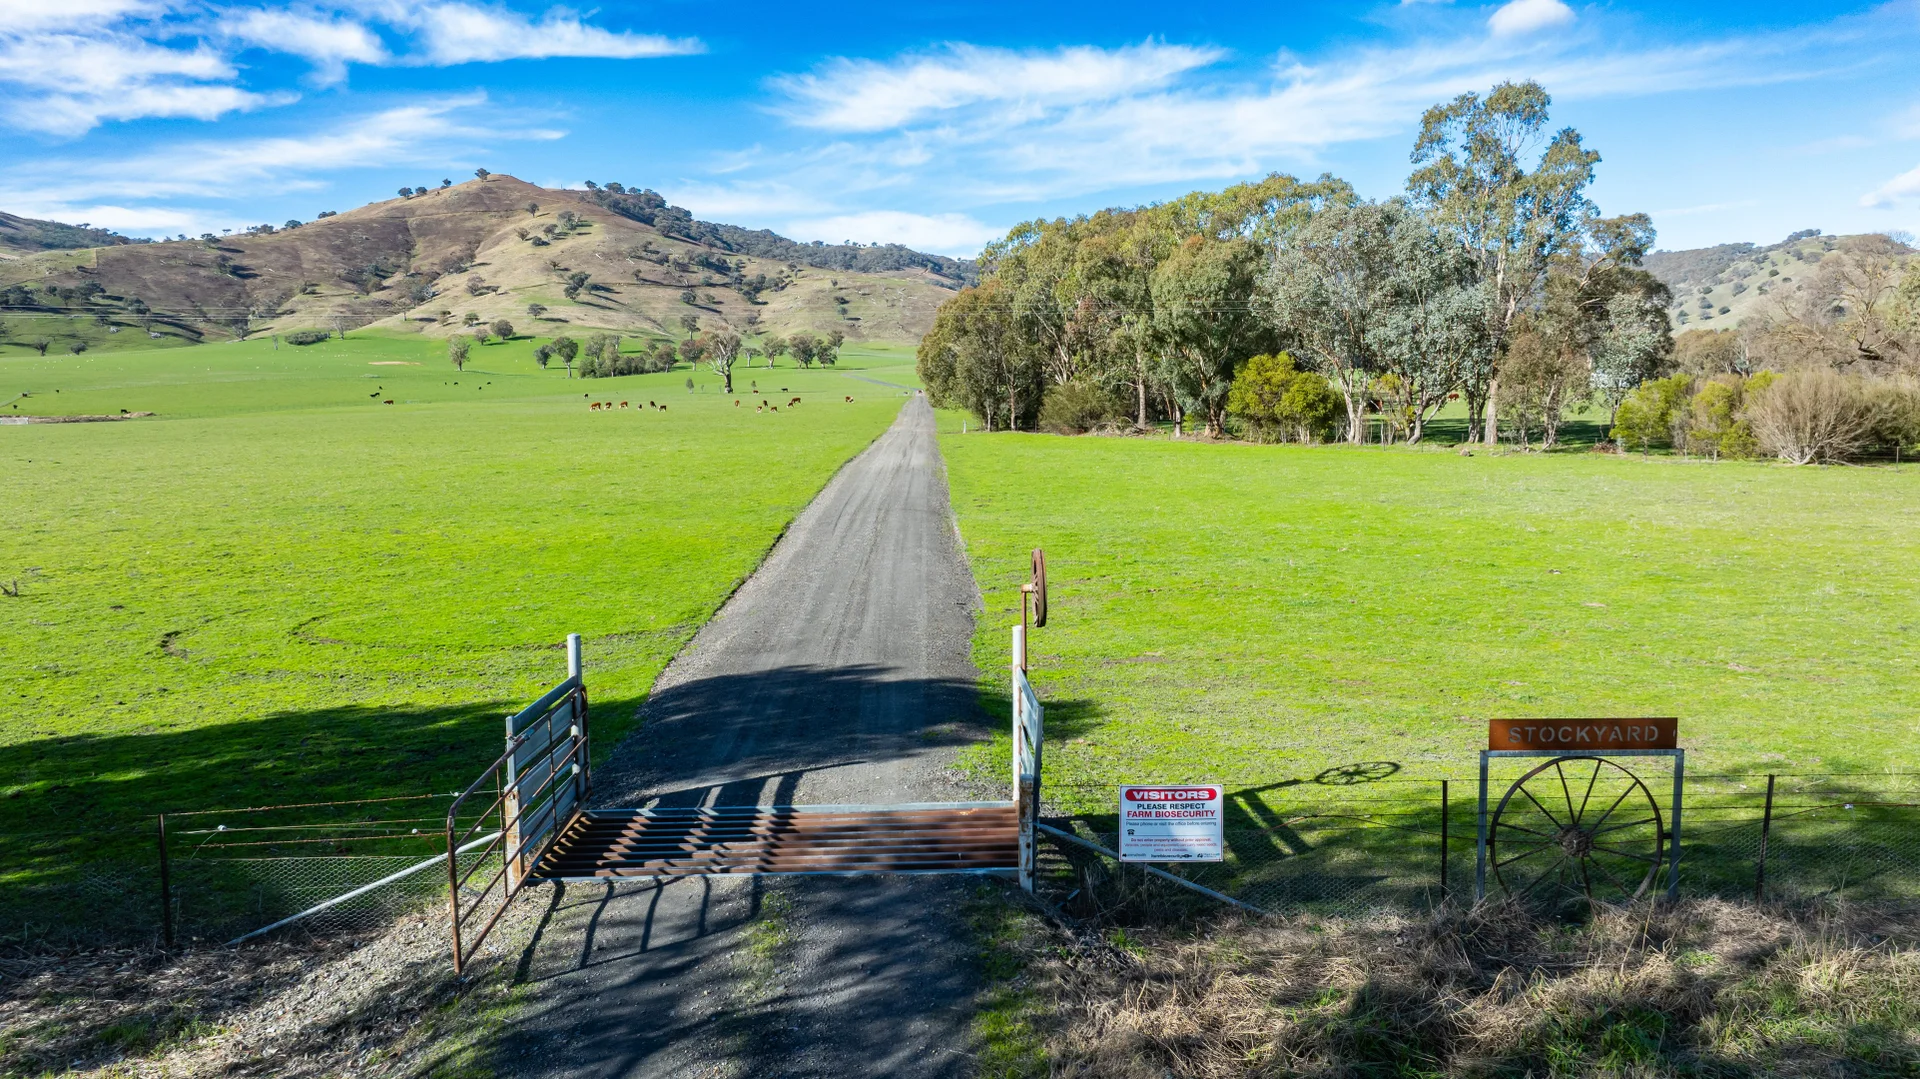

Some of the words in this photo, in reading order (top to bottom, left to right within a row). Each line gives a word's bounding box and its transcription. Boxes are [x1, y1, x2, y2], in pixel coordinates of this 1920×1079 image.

[1508, 726, 1659, 743] STOCKYARD
[1132, 790, 1209, 800] VISITORS
[1127, 810, 1152, 818] FARM
[1155, 810, 1216, 818] BIOSECURITY
